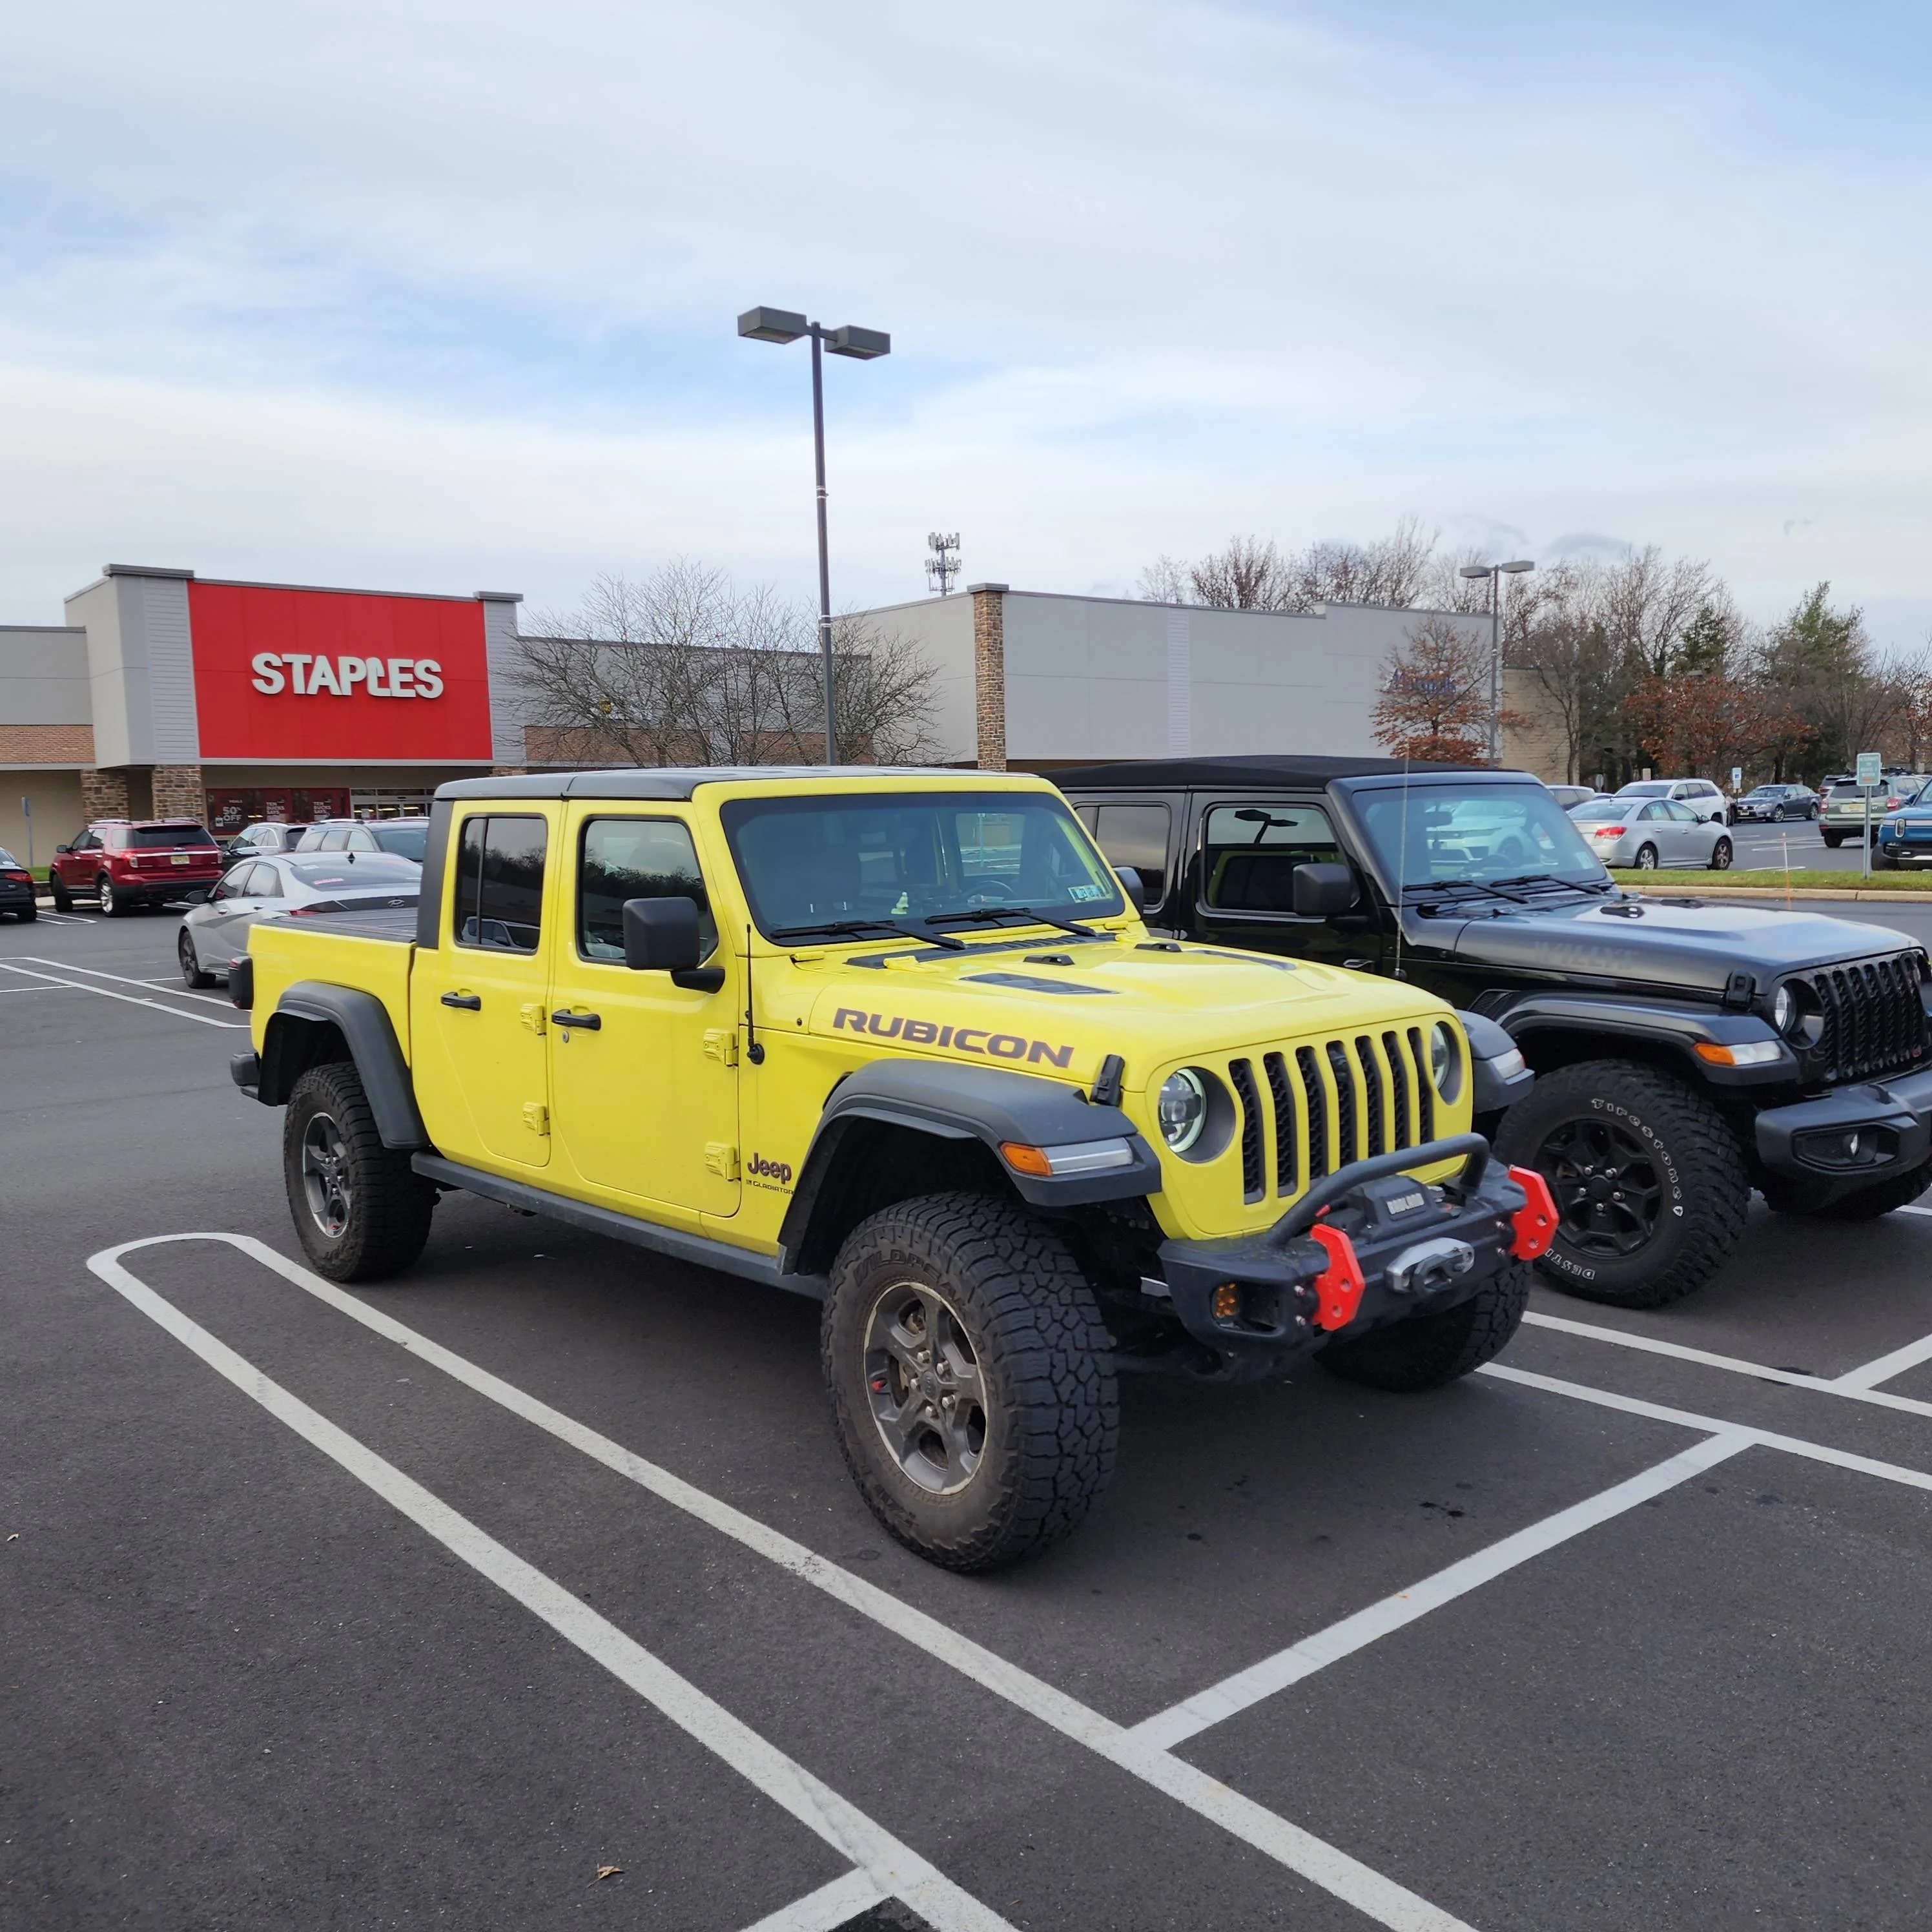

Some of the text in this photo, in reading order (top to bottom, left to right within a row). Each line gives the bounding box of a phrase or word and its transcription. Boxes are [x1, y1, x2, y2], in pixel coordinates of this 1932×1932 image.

[252, 652, 444, 699] STAPLES
[833, 1007, 1074, 1069] RUBICON
[747, 1152, 792, 1185] Jeep
[753, 1181, 794, 1195] GLADIATOR
